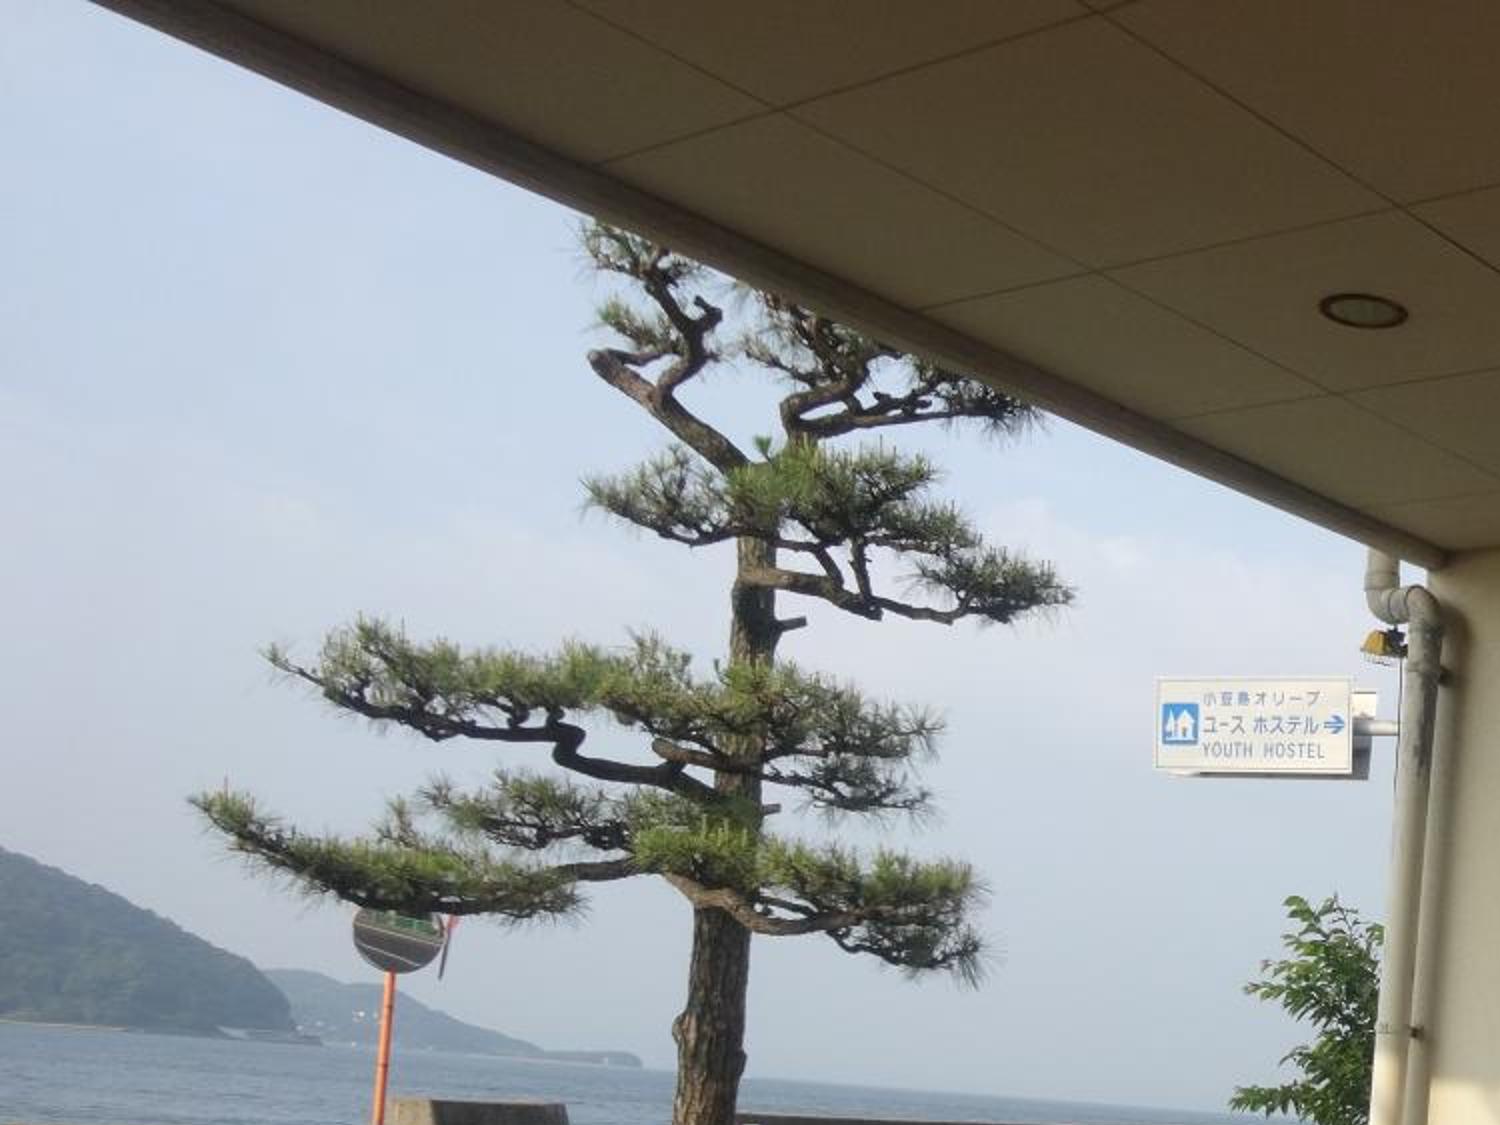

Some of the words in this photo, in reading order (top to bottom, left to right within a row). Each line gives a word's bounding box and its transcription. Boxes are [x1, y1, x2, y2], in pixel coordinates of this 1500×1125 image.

[1203, 715, 1246, 735] ユース
[1253, 714, 1320, 735] ホステル
[1202, 741, 1253, 759] YOUTH
[1263, 742, 1326, 760] HOSTEL
